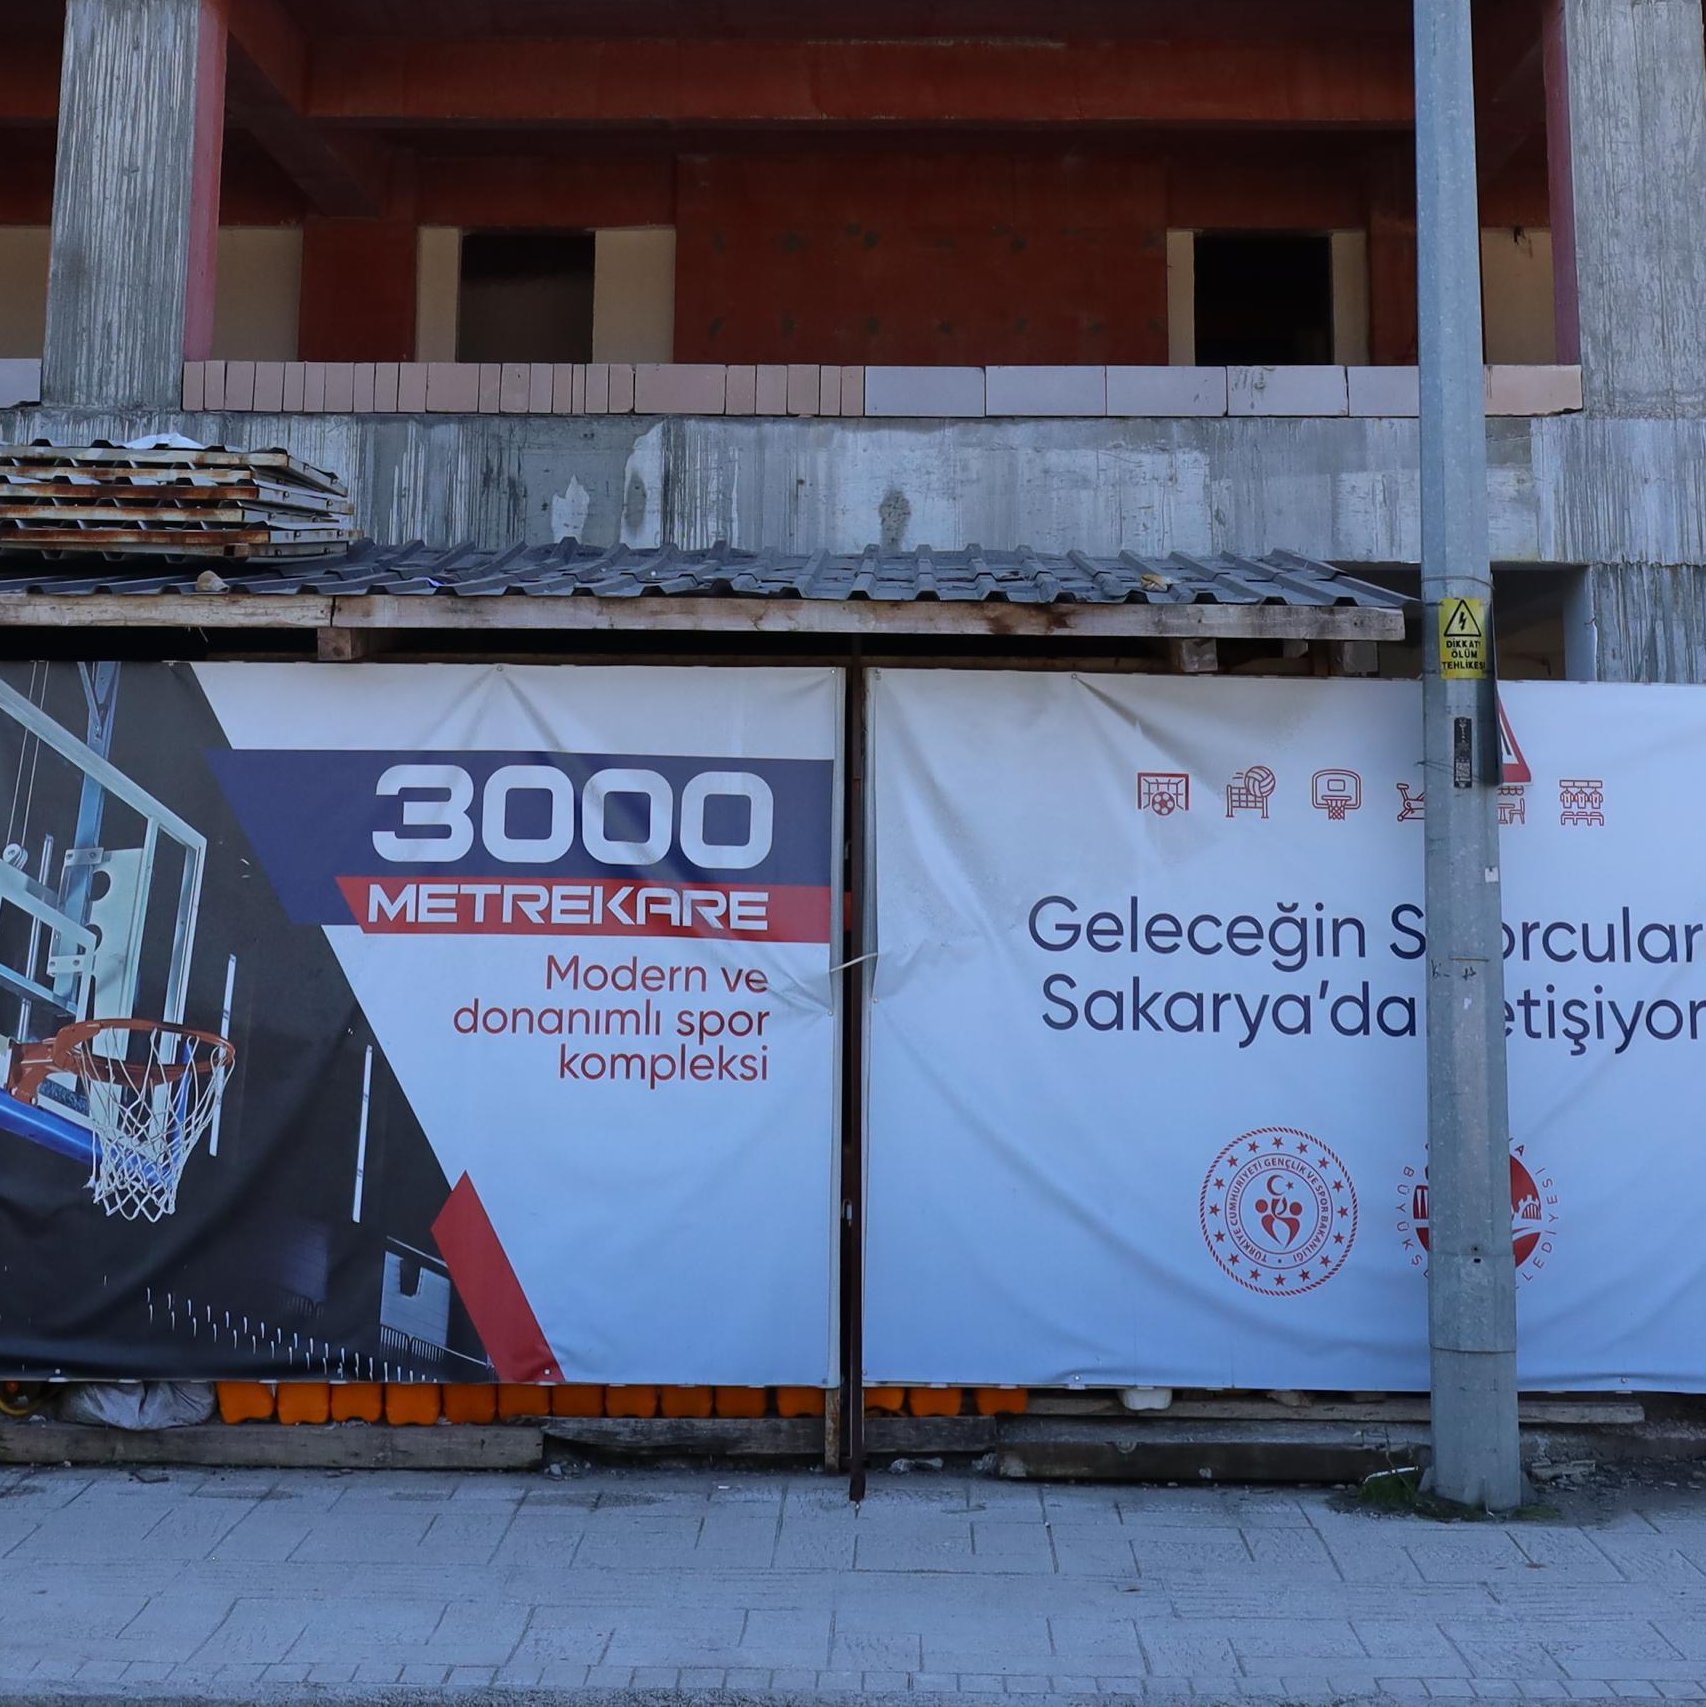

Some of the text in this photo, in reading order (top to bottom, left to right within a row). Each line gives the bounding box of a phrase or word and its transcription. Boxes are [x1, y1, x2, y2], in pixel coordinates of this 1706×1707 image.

[1451, 649, 1478, 658] ÖLÜM
[373, 765, 773, 869] 3000
[368, 884, 768, 930] METREKARE
[1029, 896, 1365, 971] Geleceğin
[547, 955, 768, 992] Modern ve
[454, 998, 770, 1044] donanımlı spor
[1043, 974, 1706, 1055] Sakarya'da tişiyor
[560, 1045, 767, 1089] kompleksi
[1264, 1157, 1306, 1175] GENÇLİK
[1307, 1171, 1319, 1185] VE
[1229, 1160, 1263, 1226] CUMHURİYETİ
[1315, 1185, 1329, 1215] SPOR
[1232, 1228, 1268, 1263] TÜRKİYE
